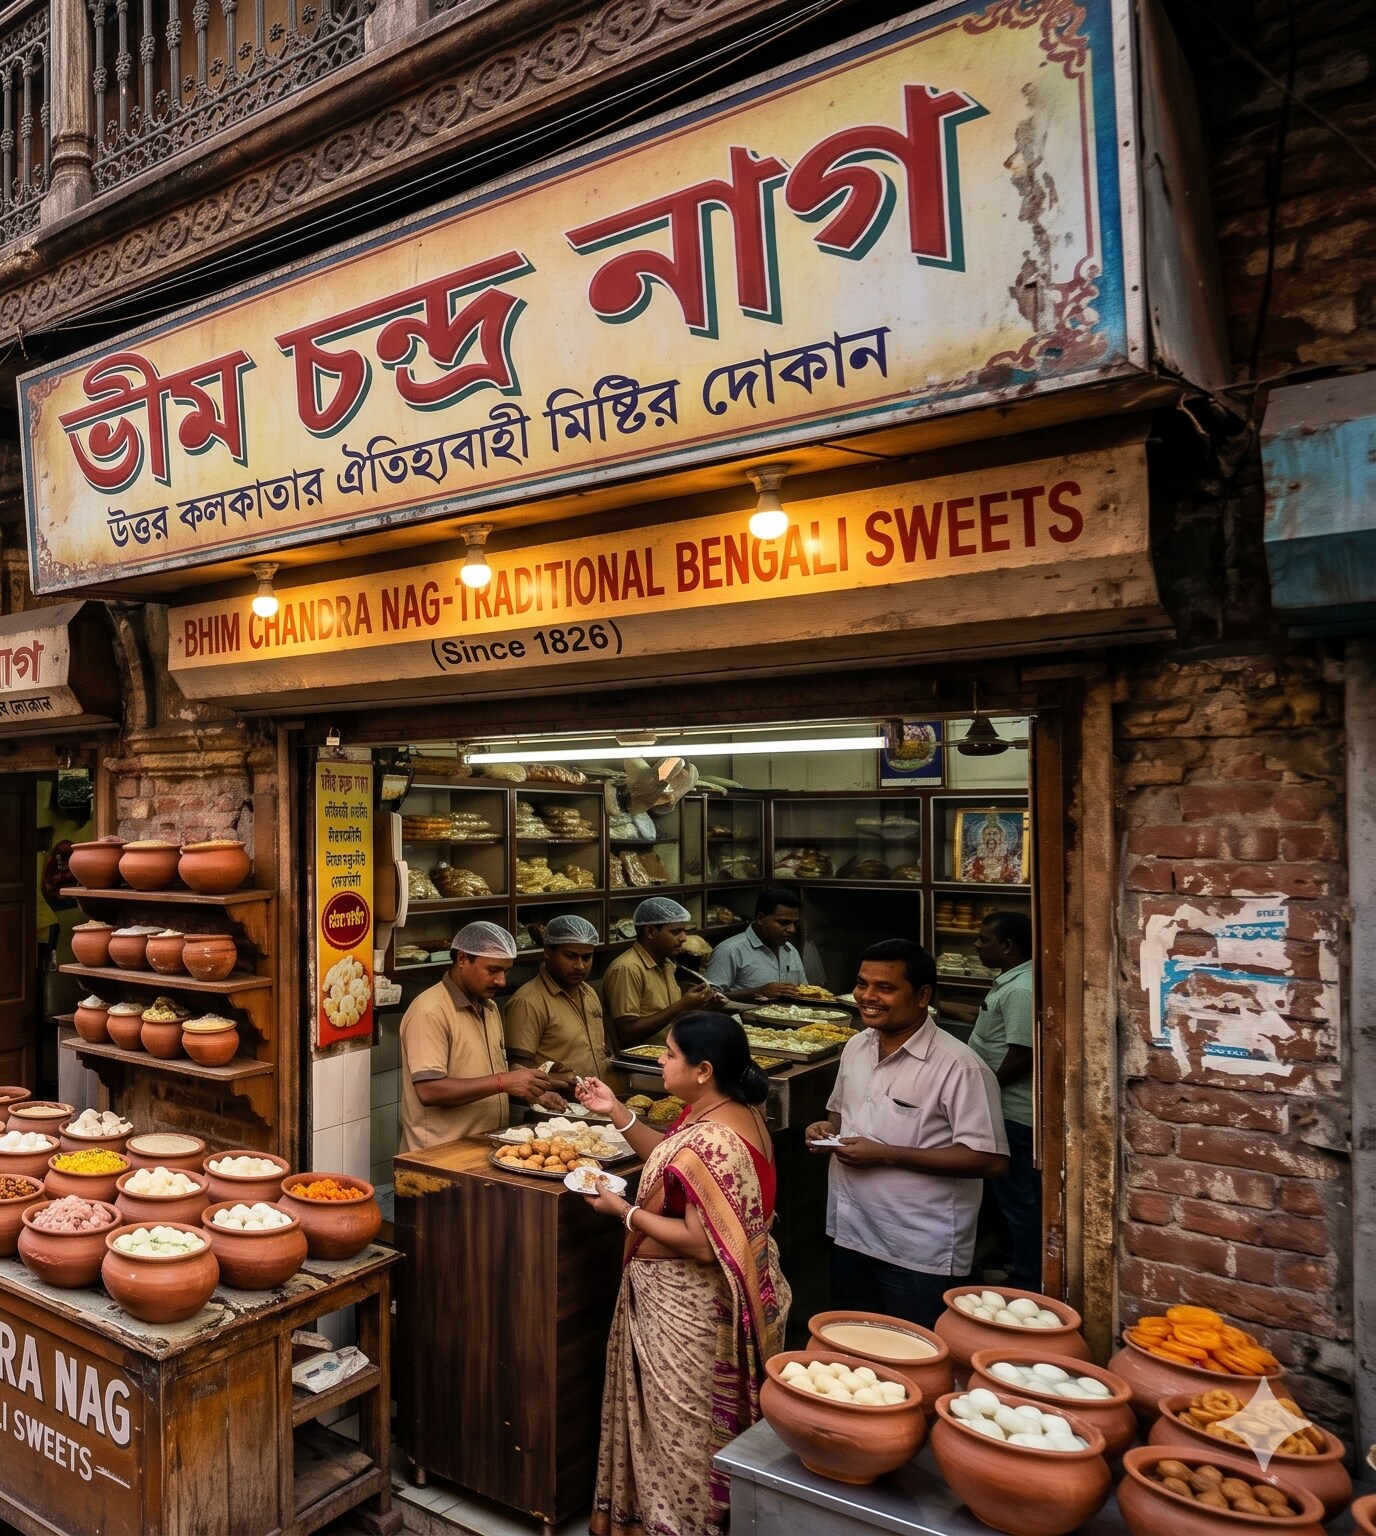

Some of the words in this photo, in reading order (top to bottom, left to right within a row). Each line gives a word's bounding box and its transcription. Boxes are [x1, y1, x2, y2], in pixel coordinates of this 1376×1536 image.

[59, 351, 255, 494] ভীম
[277, 250, 536, 440] চন্দ্র
[564, 84, 990, 340] নাগ
[107, 506, 169, 547] উত্তর
[176, 468, 326, 532] কলকাতার
[337, 403, 531, 495] ঐতিহ্যবাহী
[544, 374, 680, 453] মিষ্টির
[703, 326, 892, 416] দোকান
[184, 612, 241, 658] BHIM
[248, 591, 372, 651] CHANDRA
[676, 516, 849, 594] BENGALI
[864, 480, 1084, 569] SWEETS
[430, 636, 526, 671] (Since
[533, 619, 625, 656] 1826)
[54, 1349, 132, 1446] NAG
